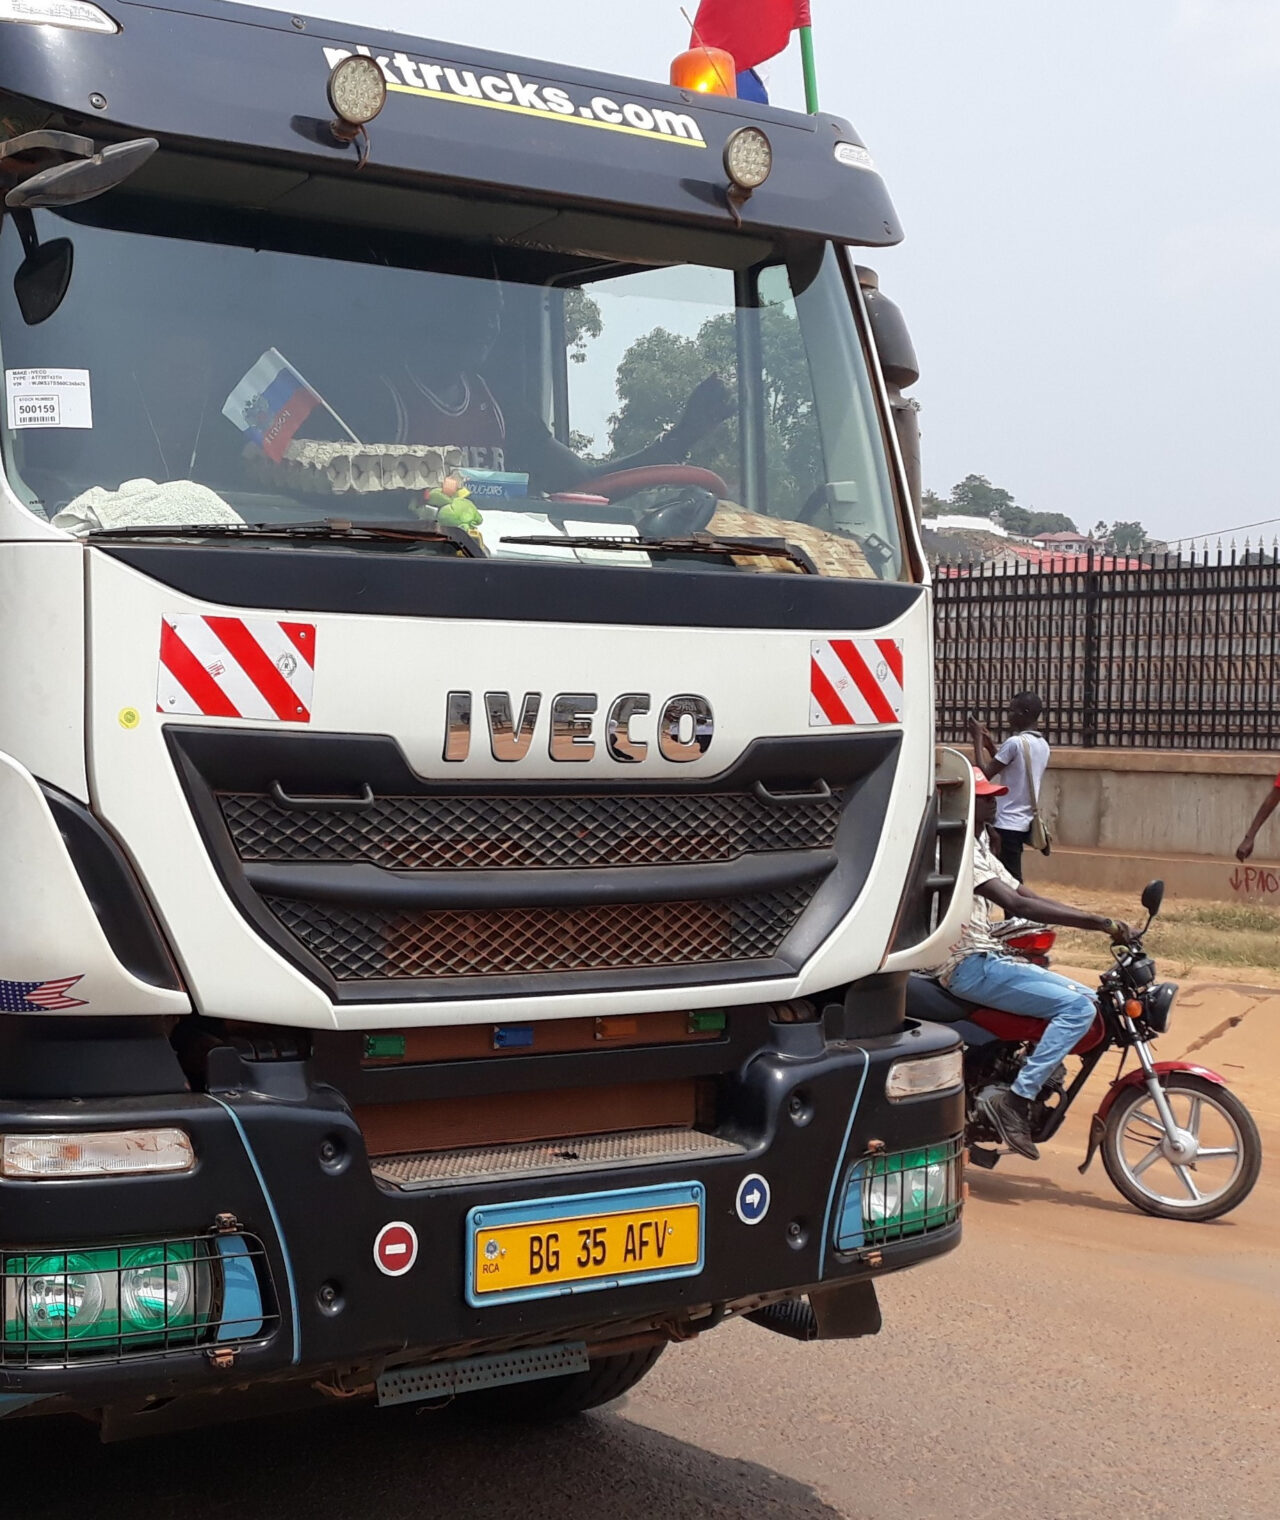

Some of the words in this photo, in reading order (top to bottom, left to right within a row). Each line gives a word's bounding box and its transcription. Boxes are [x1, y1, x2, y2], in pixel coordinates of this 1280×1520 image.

[19, 404, 55, 414] 500159
[442, 690, 715, 763] IVECO
[529, 1233, 560, 1275] BG
[577, 1227, 607, 1267] 35
[624, 1220, 668, 1263] AFV
[482, 1263, 500, 1274] RCA
